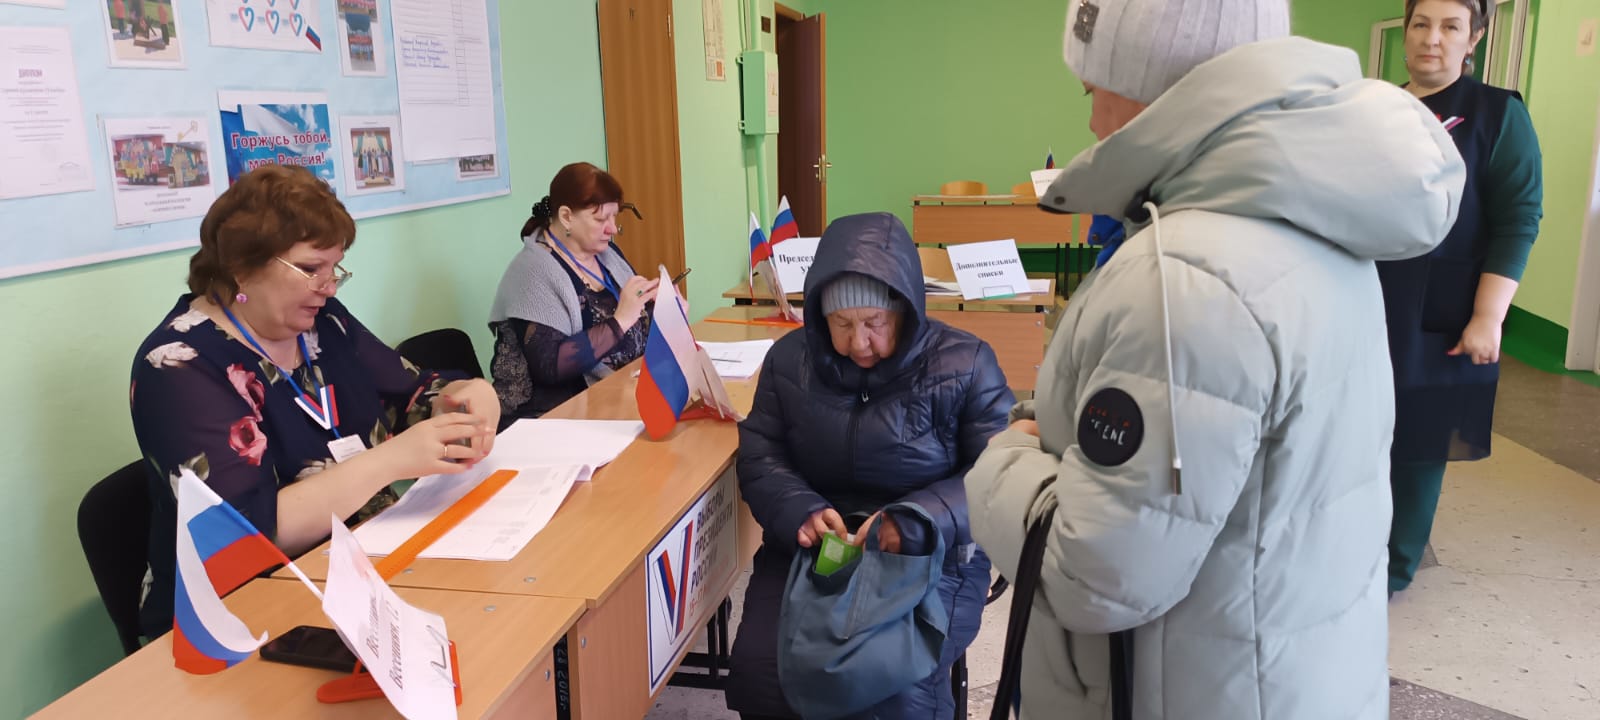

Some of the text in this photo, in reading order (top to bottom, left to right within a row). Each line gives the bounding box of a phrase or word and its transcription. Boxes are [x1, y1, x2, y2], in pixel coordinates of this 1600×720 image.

[231, 130, 331, 151] Горжусь тобой,
[278, 152, 325, 167] Россия!
[955, 258, 1018, 271] Дополнительные
[977, 270, 1004, 279] списки
[697, 487, 725, 533] ВЫБОРЫ
[693, 500, 733, 562] ПРЕЗИДЕНТА
